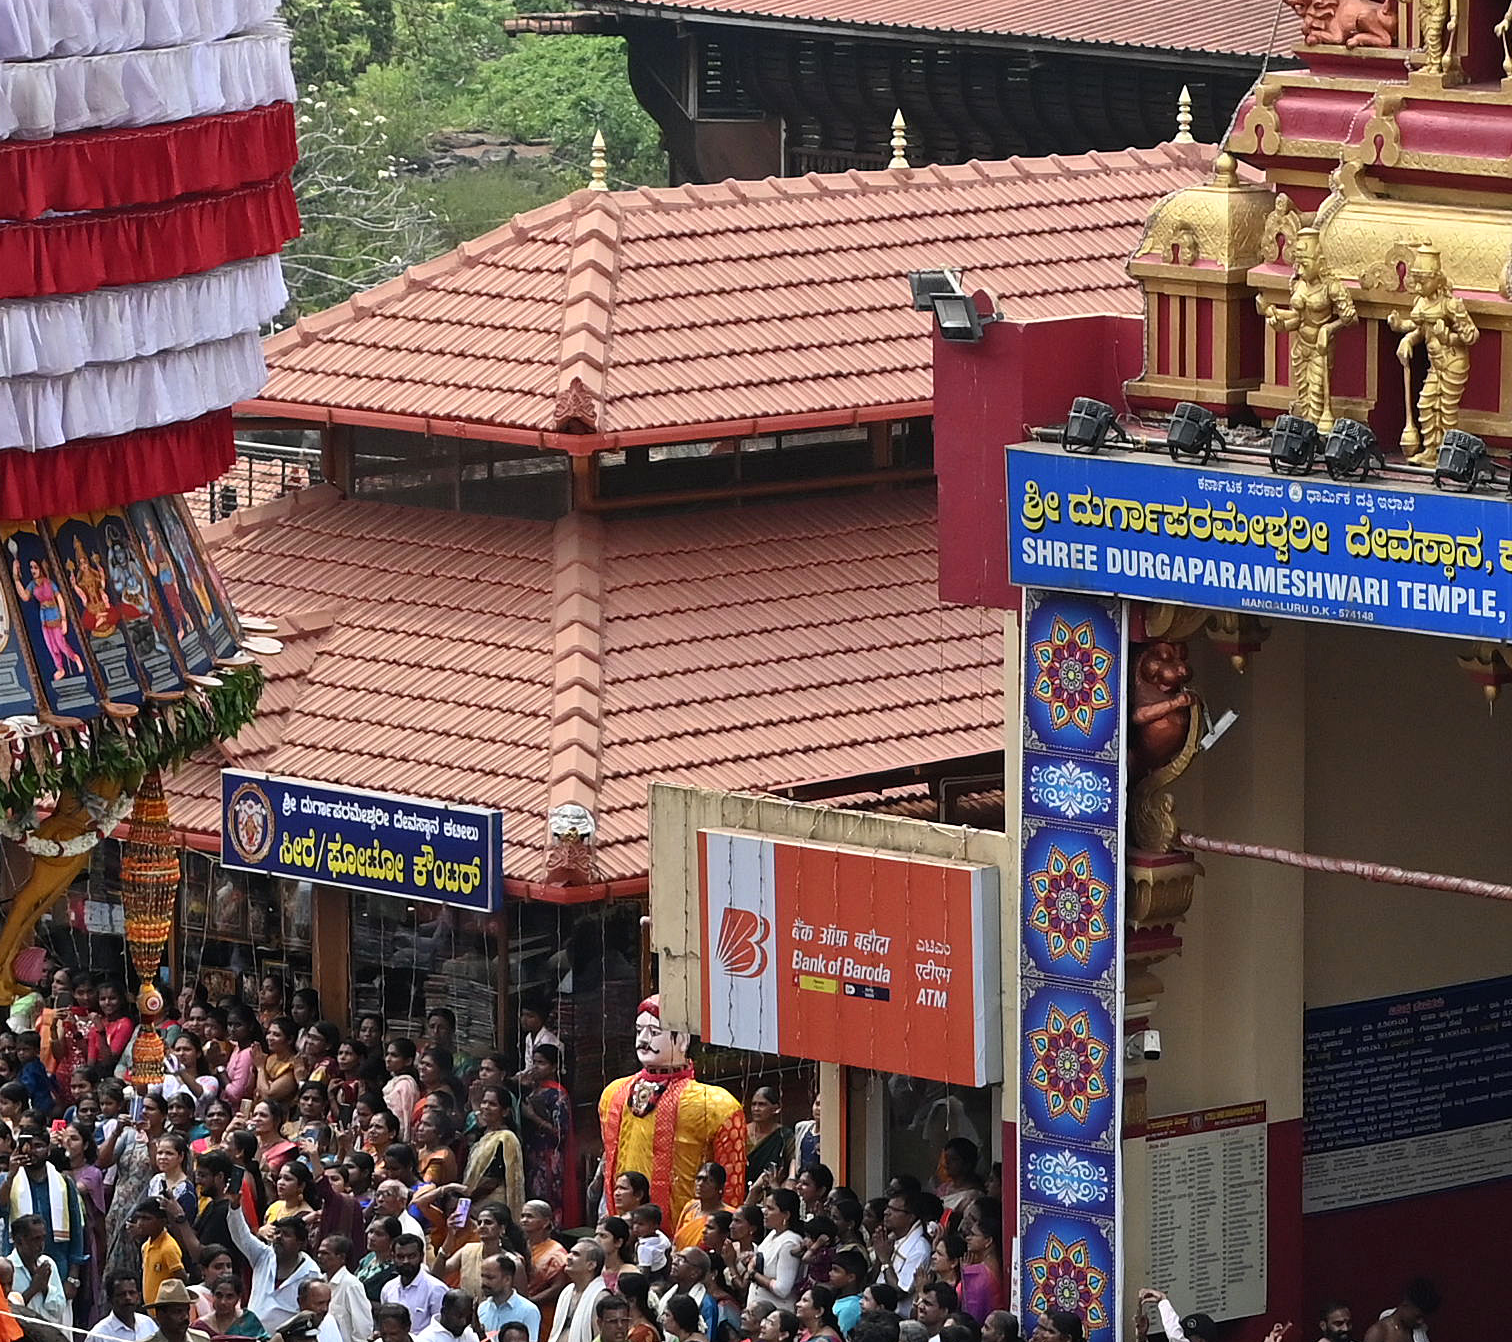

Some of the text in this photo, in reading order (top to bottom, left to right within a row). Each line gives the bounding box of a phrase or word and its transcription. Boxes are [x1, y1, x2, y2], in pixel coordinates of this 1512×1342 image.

[1247, 480, 1284, 498] ಸರಕಾರ
[1021, 480, 1061, 530] ಶ್ರೀ
[1067, 484, 1330, 562] ದುರ್ಗಾಪರಮೇಶ್ವರೀ
[1021, 537, 1098, 571] SHREE
[1106, 546, 1390, 607] DURGAPARAMESHWARI
[1397, 580, 1506, 624] TEMPLE,
[1241, 597, 1309, 614] MANGALURU
[1311, 606, 1330, 616] D.K
[1338, 608, 1374, 621] 574148
[282, 792, 479, 842] ಶ್ರೀ ದುರ್ಗಾಪರಮೇಶ್ವರೀ ದೇವಸ್ಥಾನ ಕಟೀಲು
[413, 843, 481, 895] ಕೌಂಟರ್
[791, 948, 891, 984] Bank of Baroda
[914, 959, 953, 985] एटीएम
[915, 987, 948, 1009] ATM
